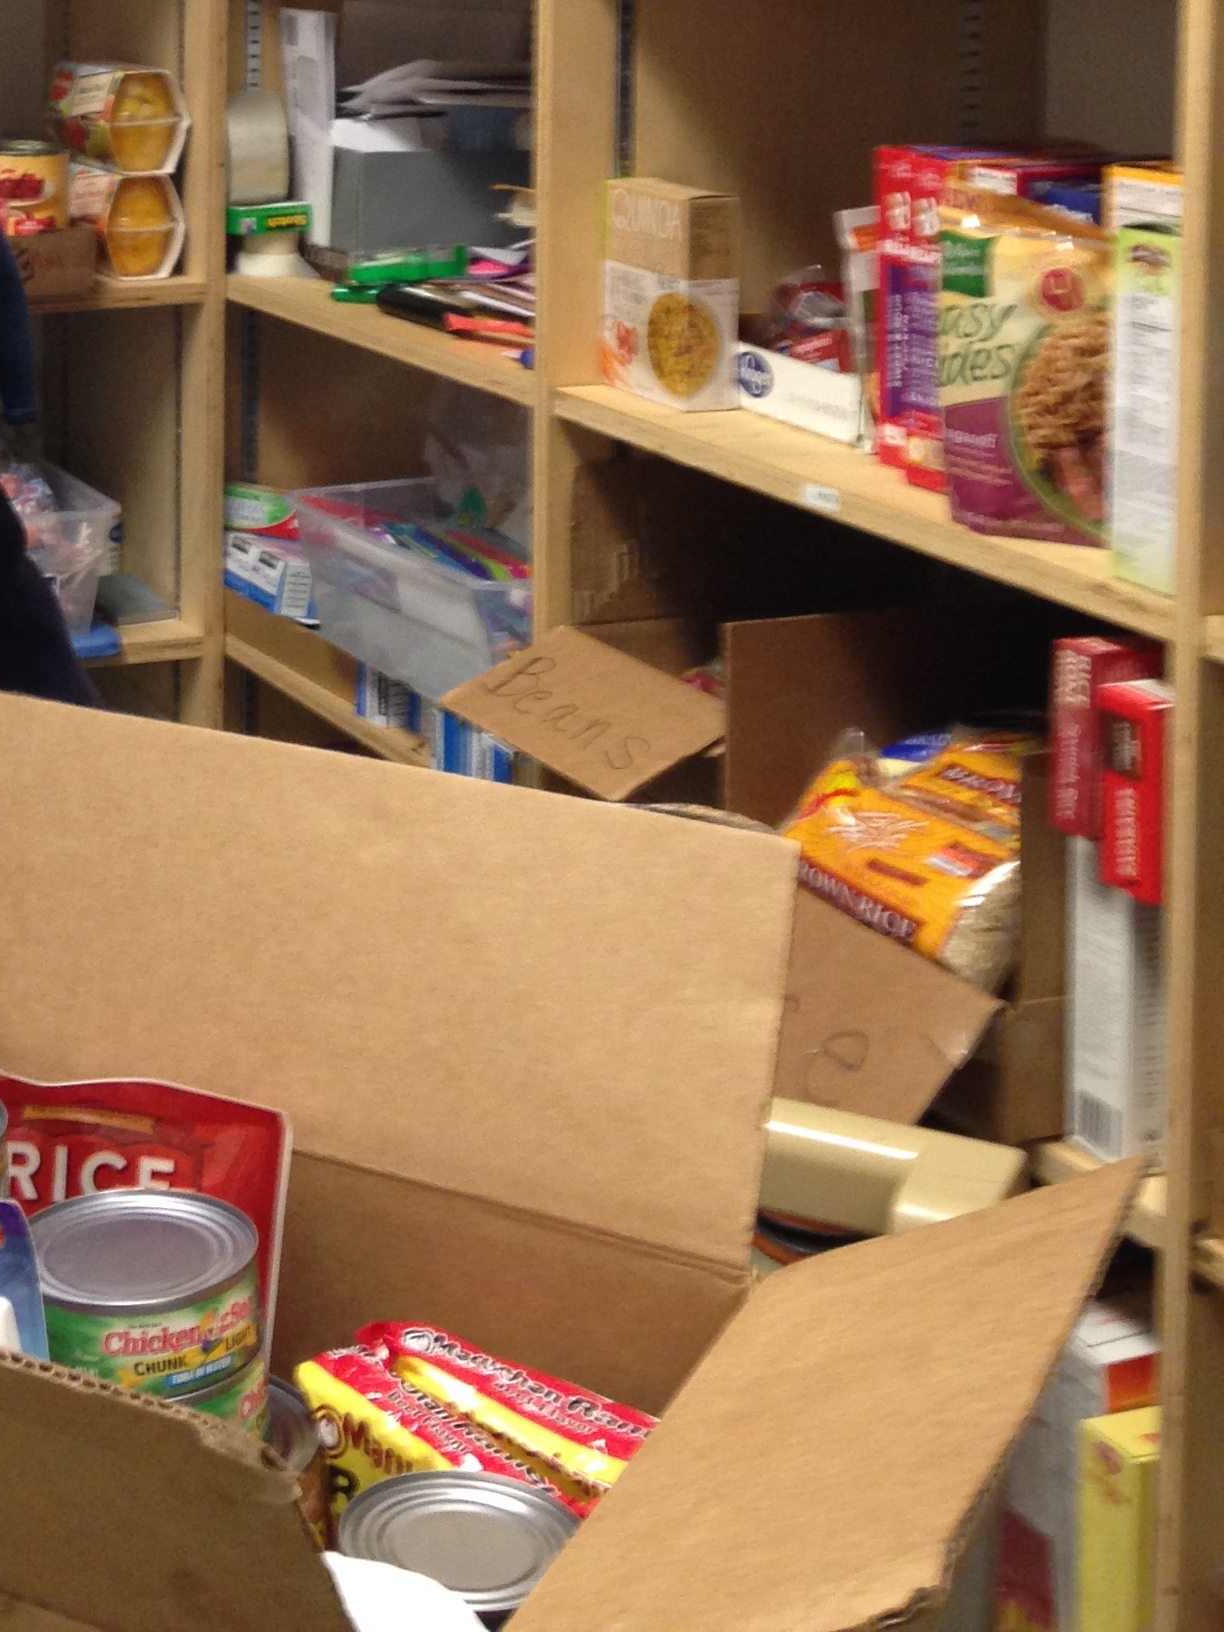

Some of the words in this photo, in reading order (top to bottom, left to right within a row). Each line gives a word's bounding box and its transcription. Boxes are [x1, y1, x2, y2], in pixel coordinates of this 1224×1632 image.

[482, 655, 652, 770] Beans
[7, 1140, 176, 1204] RICE
[102, 1325, 200, 1357] Chicken
[133, 1355, 187, 1377] CHUNK
